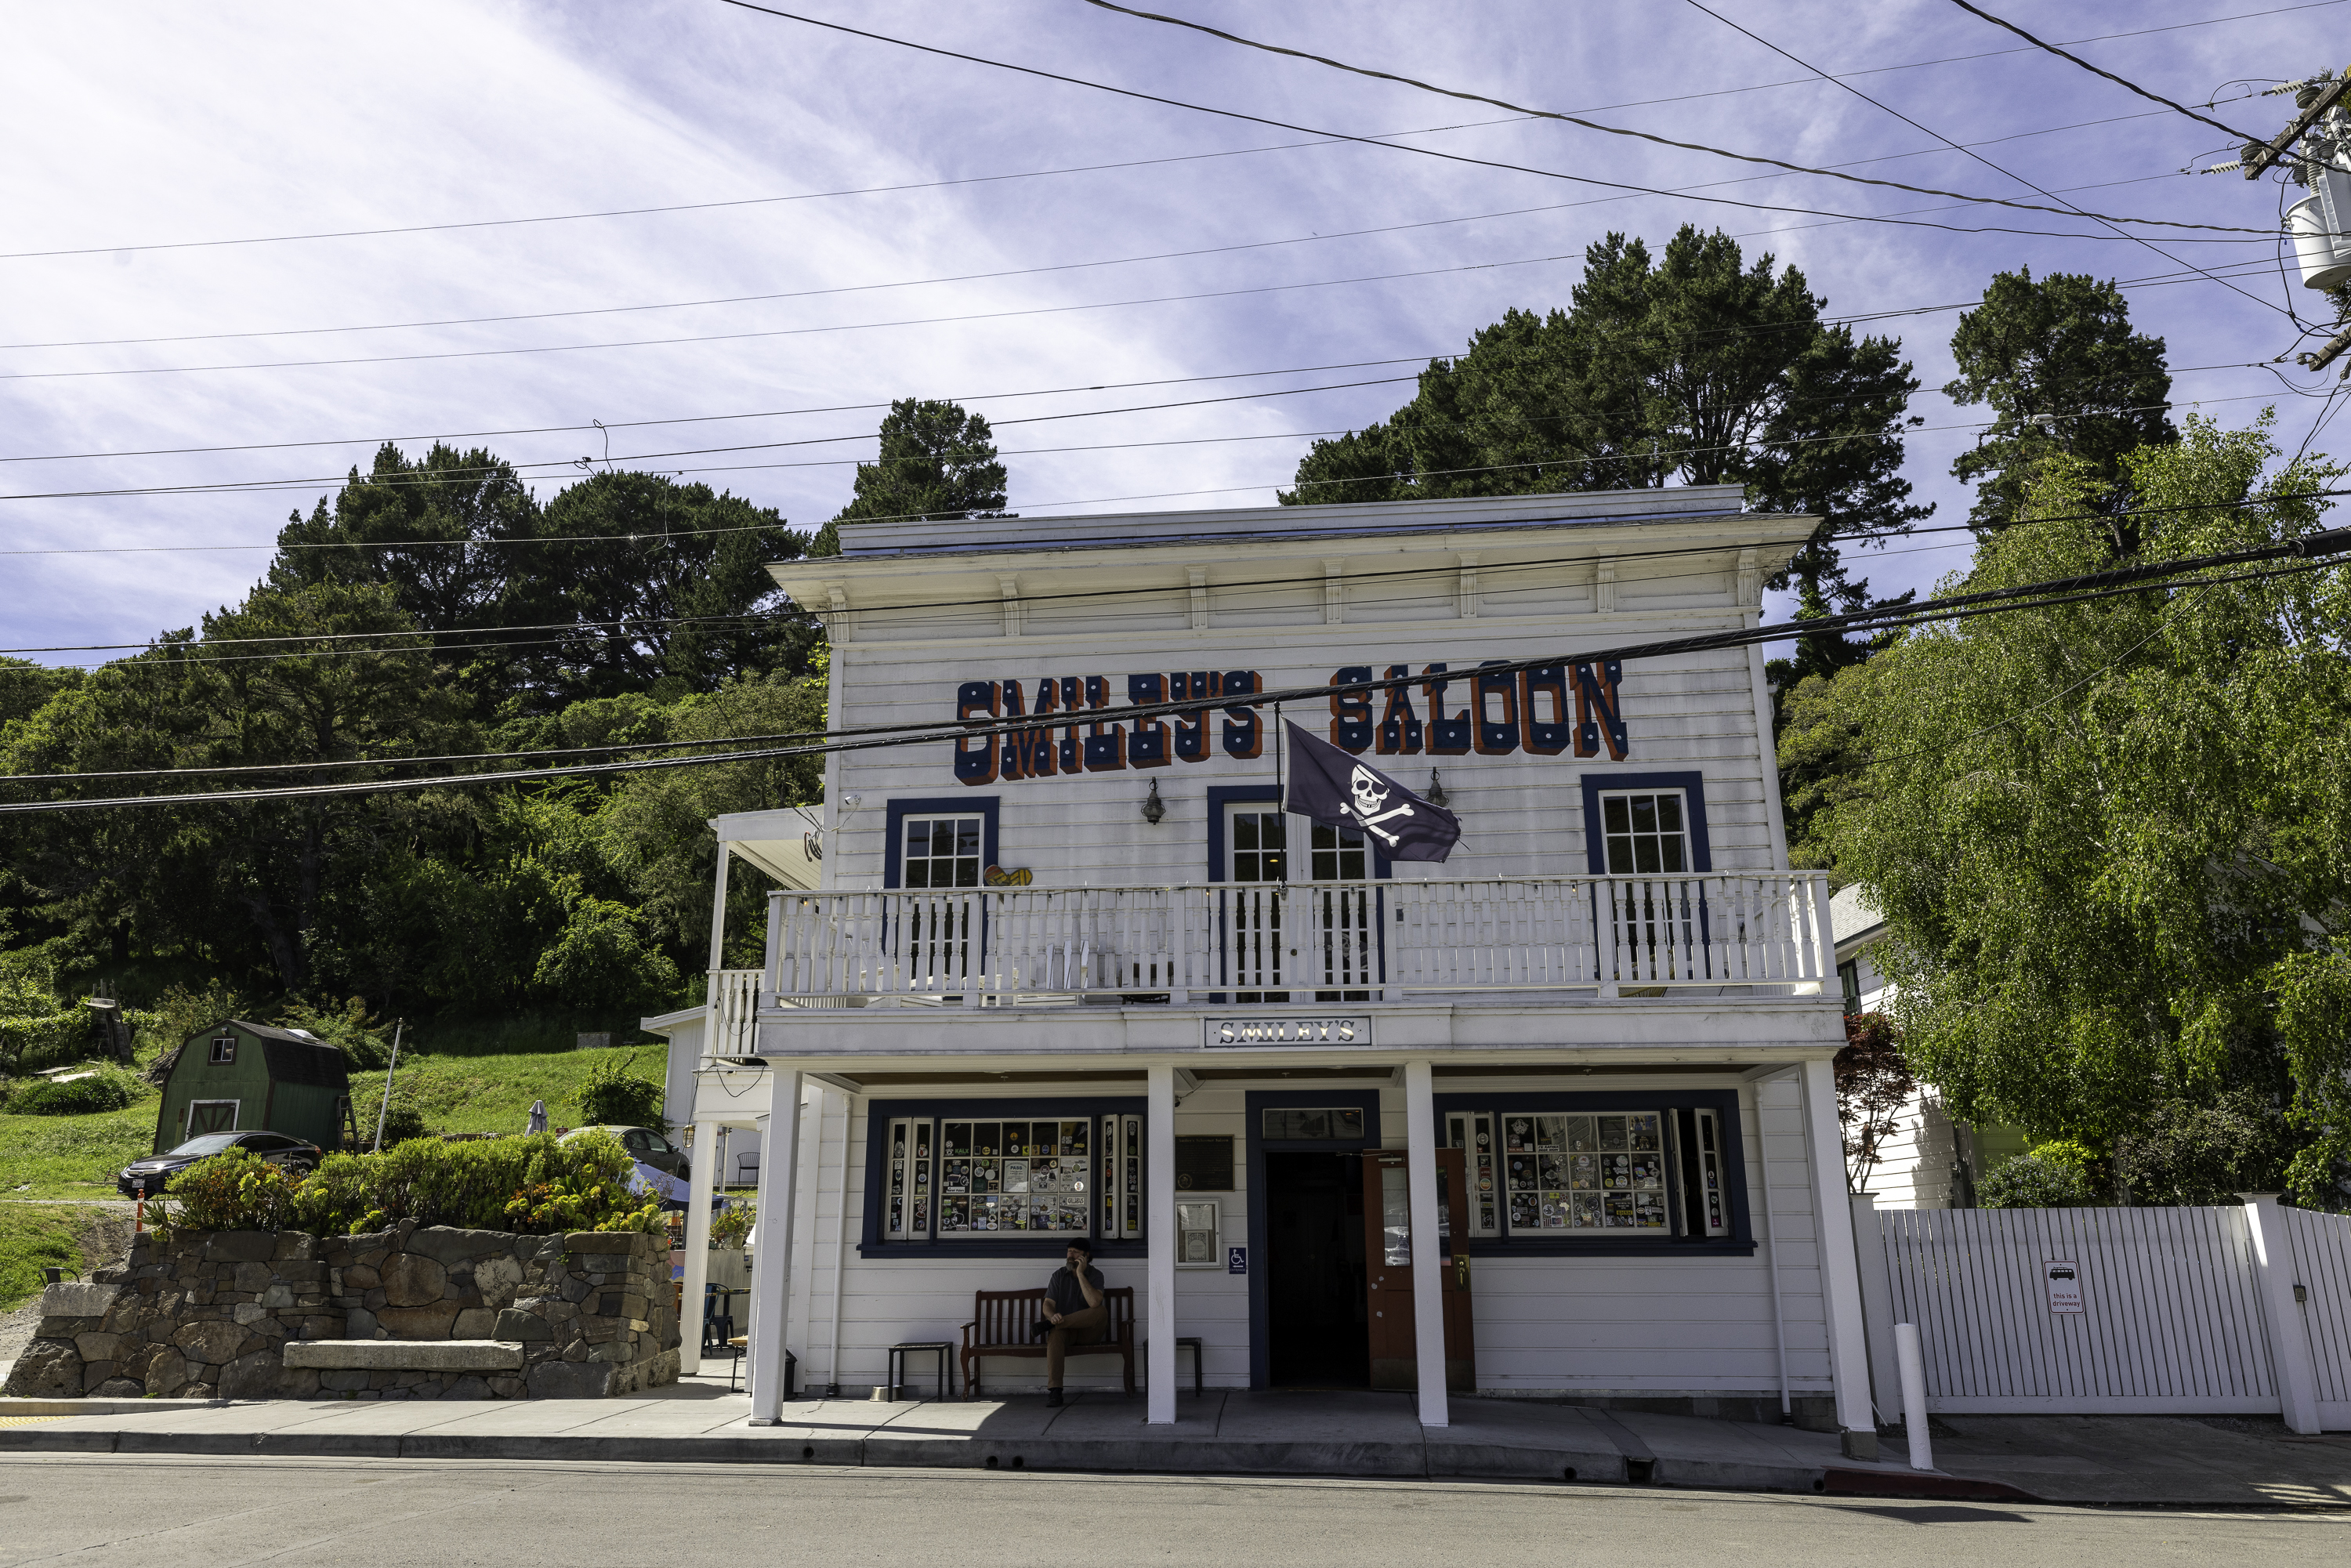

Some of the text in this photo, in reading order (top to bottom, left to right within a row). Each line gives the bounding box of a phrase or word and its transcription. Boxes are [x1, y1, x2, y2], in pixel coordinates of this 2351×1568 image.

[954, 660, 1628, 786] SMILEY'S SALOON
[1219, 1019, 1355, 1044] SMILEY'S
